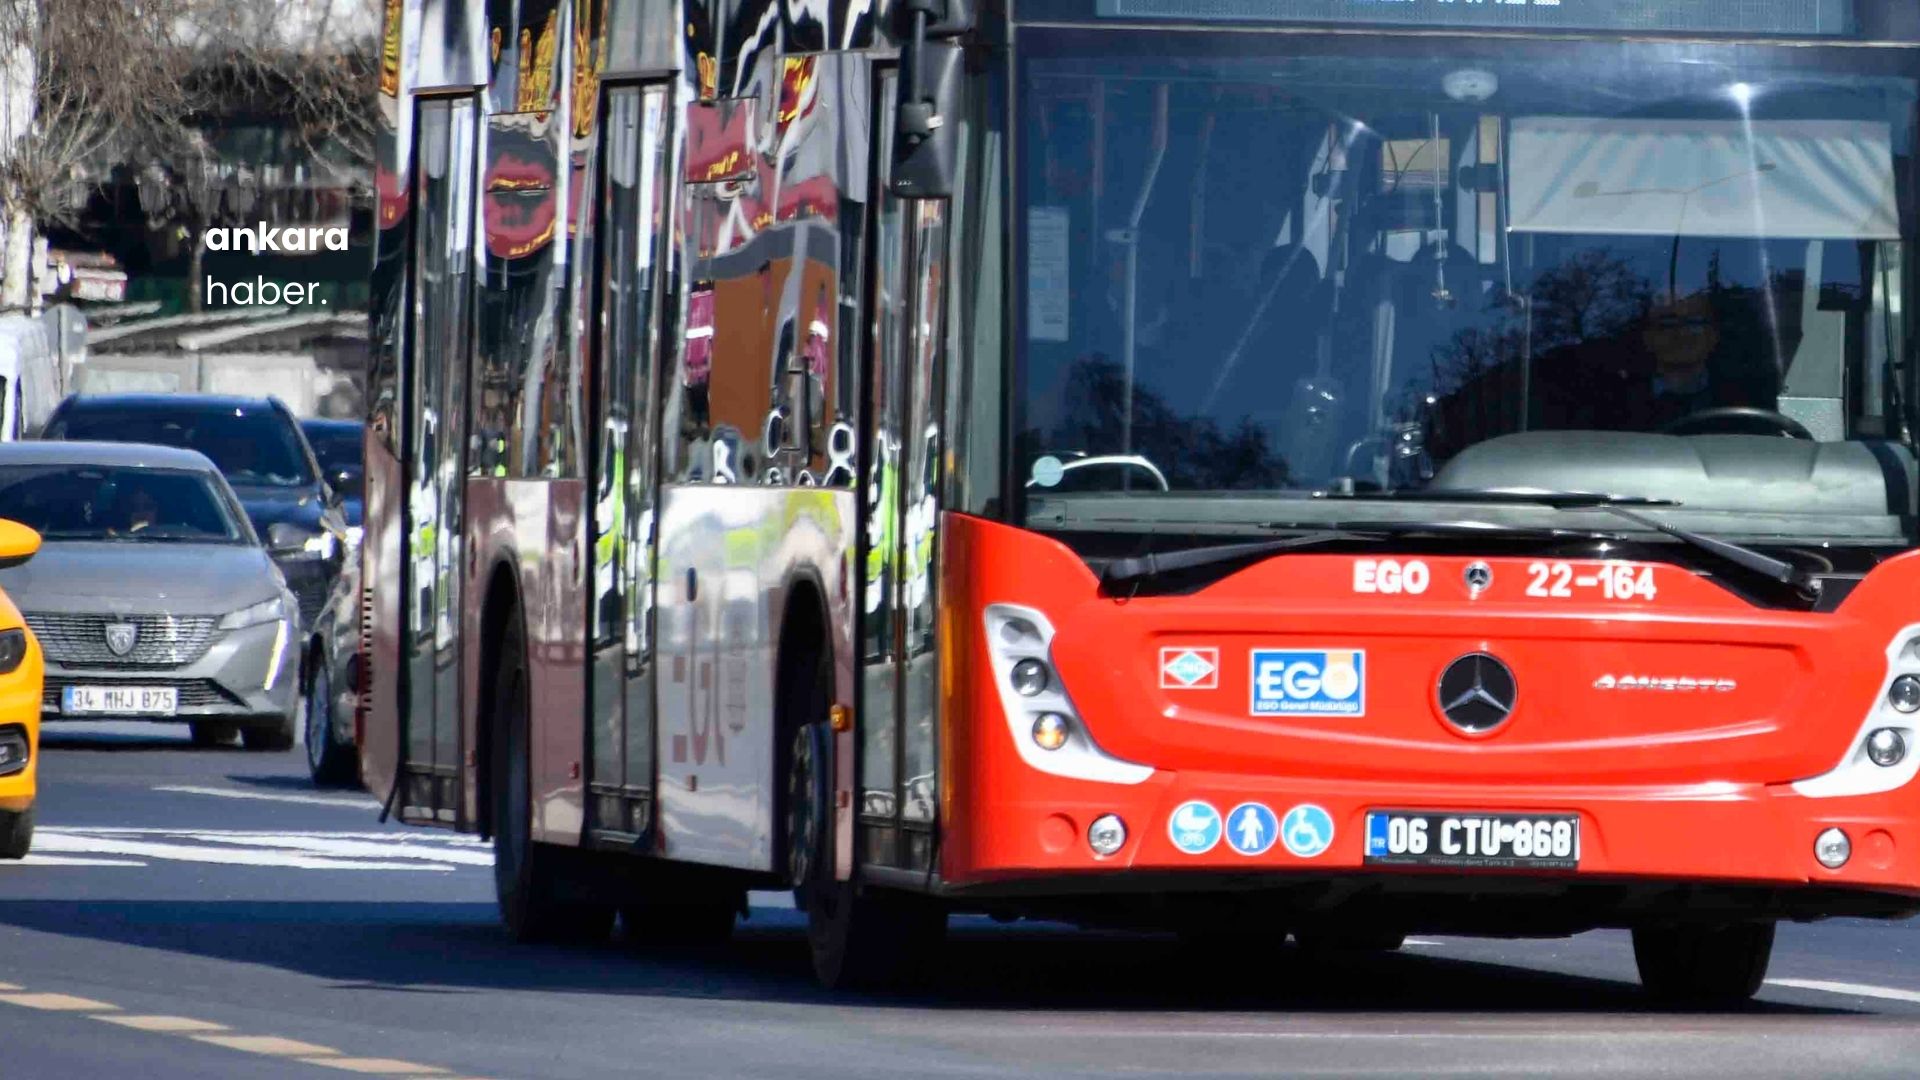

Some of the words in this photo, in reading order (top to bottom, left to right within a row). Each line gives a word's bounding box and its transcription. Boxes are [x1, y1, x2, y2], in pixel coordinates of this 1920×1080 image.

[1352, 559, 1430, 594] EGO
[1525, 562, 1658, 600] 22-164
[74, 690, 94, 709] 34
[104, 690, 135, 709] MHJ
[1256, 660, 1359, 700] EGO
[1372, 838, 1386, 849] TR
[1388, 817, 1429, 855] 06
[1440, 818, 1501, 856] CTU
[1512, 820, 1572, 858] 868
